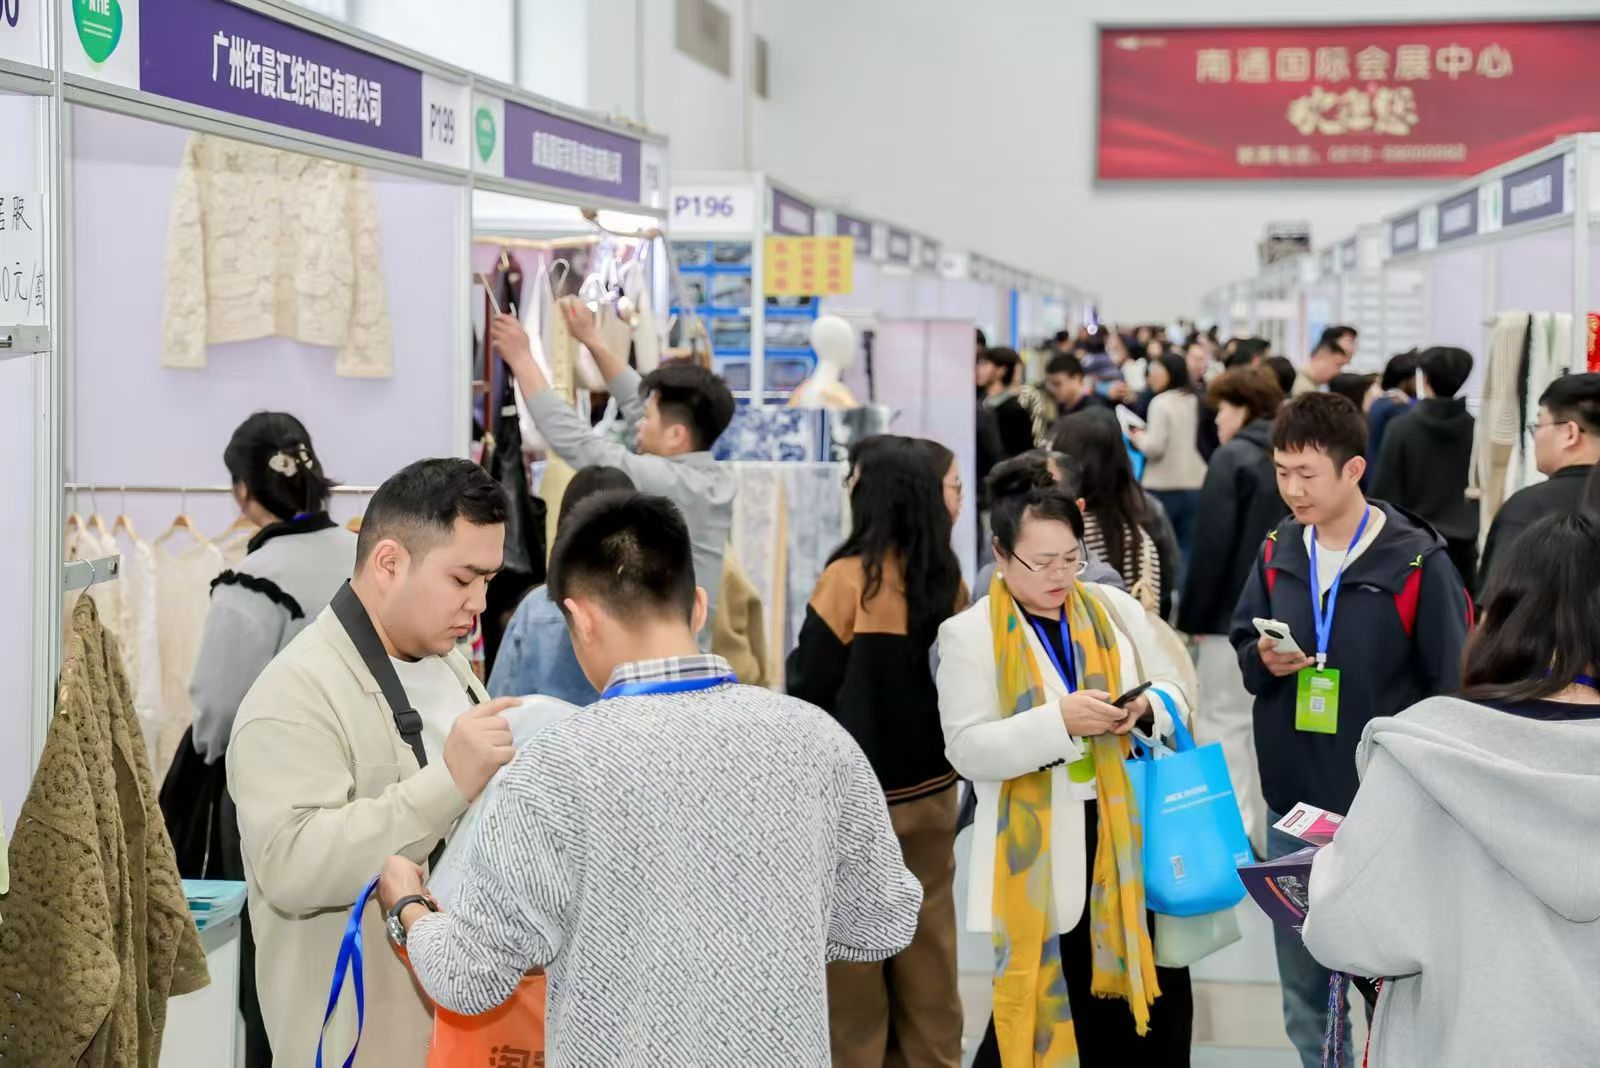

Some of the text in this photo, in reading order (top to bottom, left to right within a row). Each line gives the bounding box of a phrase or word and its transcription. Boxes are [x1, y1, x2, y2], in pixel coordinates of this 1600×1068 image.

[212, 30, 382, 127] 广州纤晨汇纺织品有限公司
[1196, 43, 1513, 83] 南通国际会展中心
[430, 103, 456, 145] P199
[674, 195, 734, 218] P196
